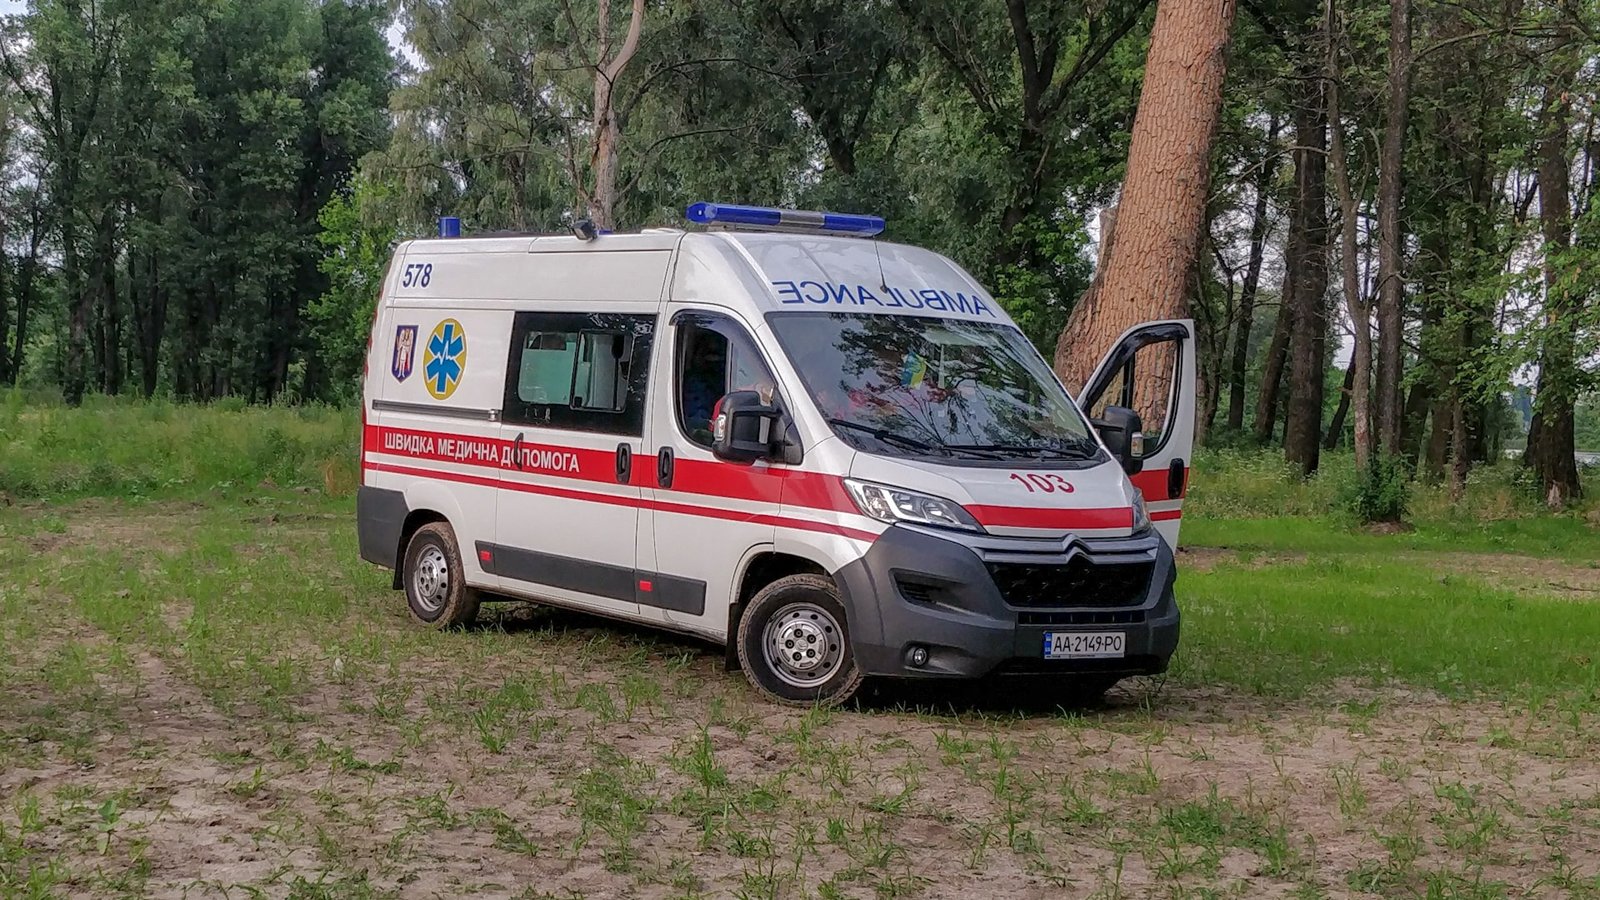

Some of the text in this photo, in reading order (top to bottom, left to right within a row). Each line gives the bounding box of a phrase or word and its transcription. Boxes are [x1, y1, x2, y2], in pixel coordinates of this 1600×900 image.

[402, 263, 432, 288] 578
[385, 432, 434, 455] ШВИДКА
[437, 438, 499, 462] МЕДИЧНА
[1009, 473, 1075, 493] 103
